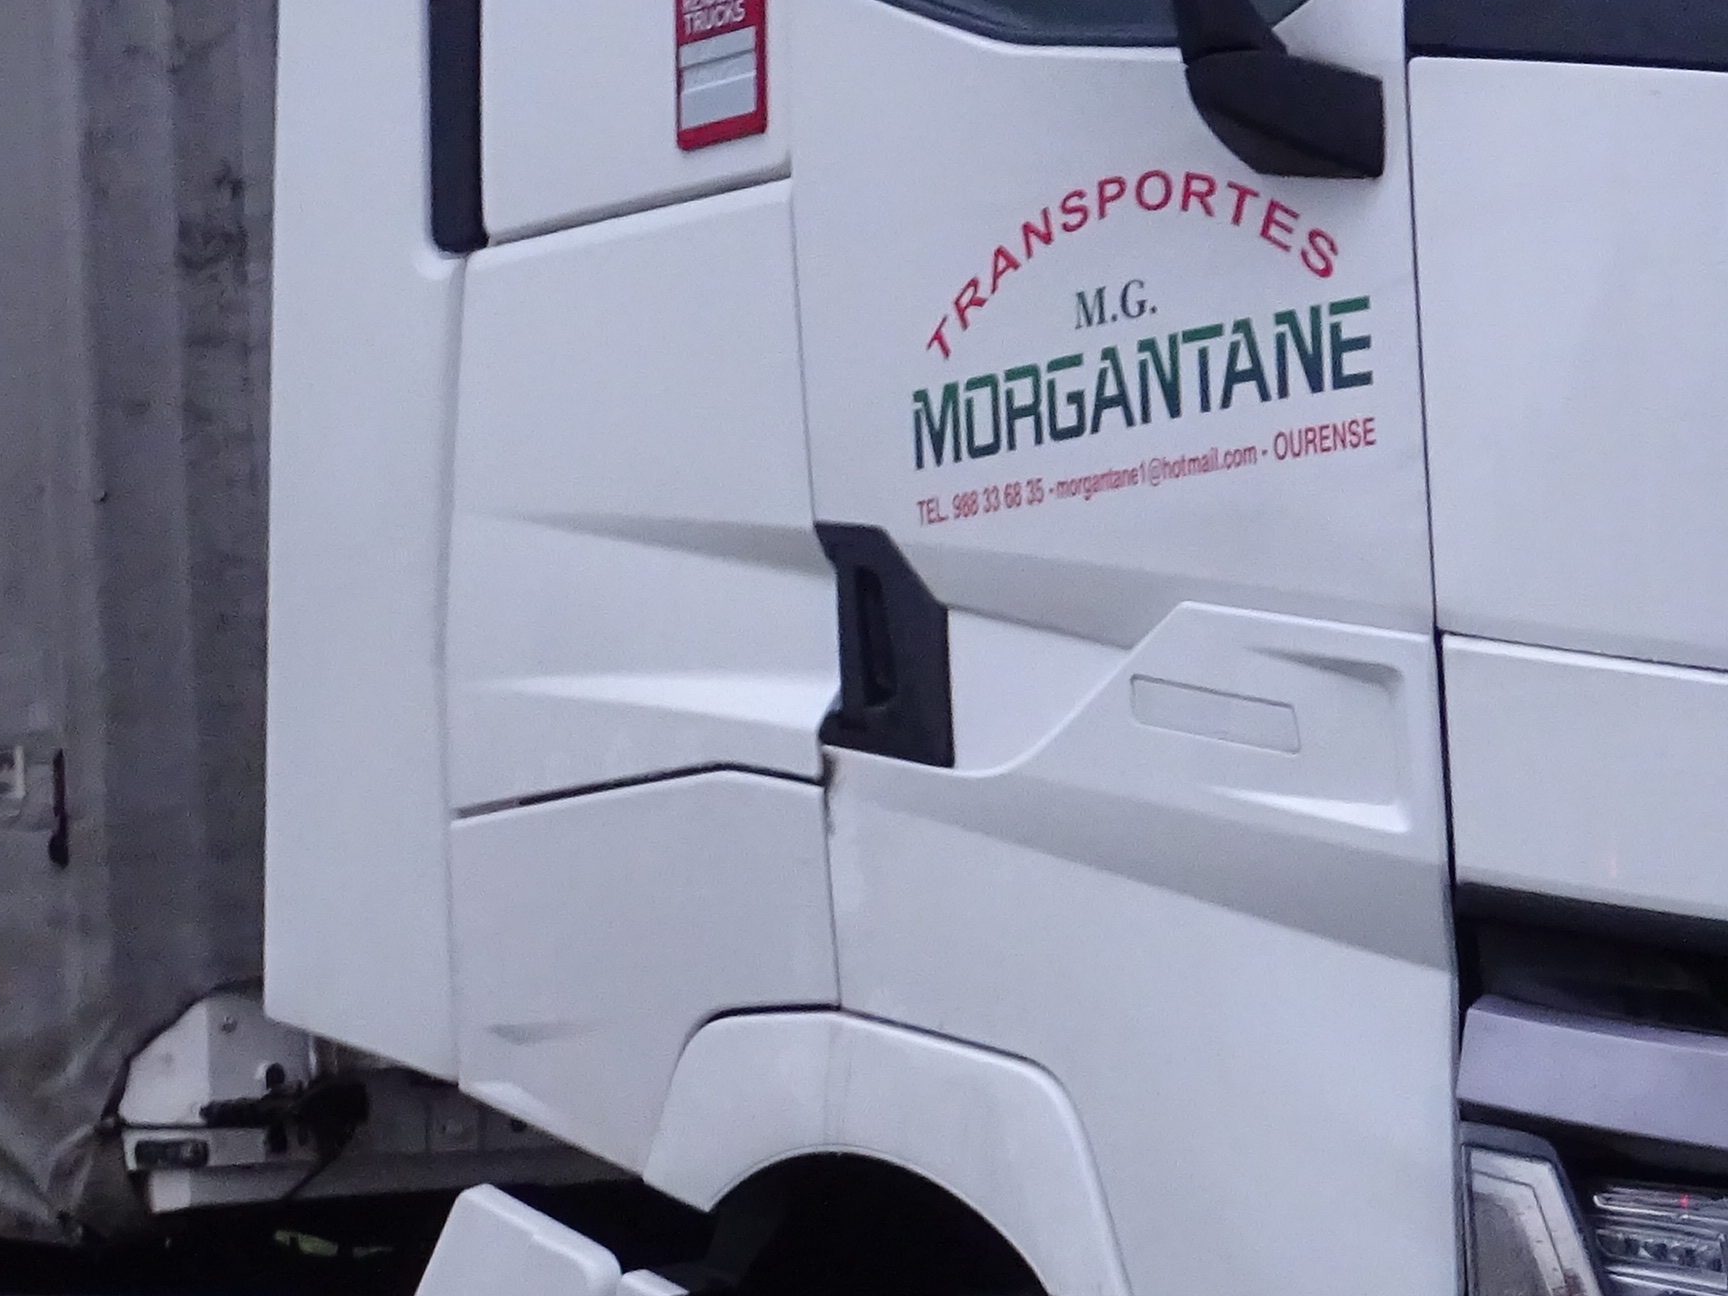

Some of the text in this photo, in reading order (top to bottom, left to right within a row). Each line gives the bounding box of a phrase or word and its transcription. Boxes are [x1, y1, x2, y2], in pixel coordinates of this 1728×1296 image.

[683, 0, 746, 35] TRUCKS
[926, 169, 1340, 360] TRANSPORTES
[1074, 279, 1158, 329] M.G.
[912, 295, 1373, 471] MORGANTANE
[952, 490, 979, 519] 988
[983, 485, 1000, 513] 33
[1004, 481, 1022, 508] 68
[1026, 477, 1044, 506] 35
[1273, 417, 1376, 461] OURENSE
